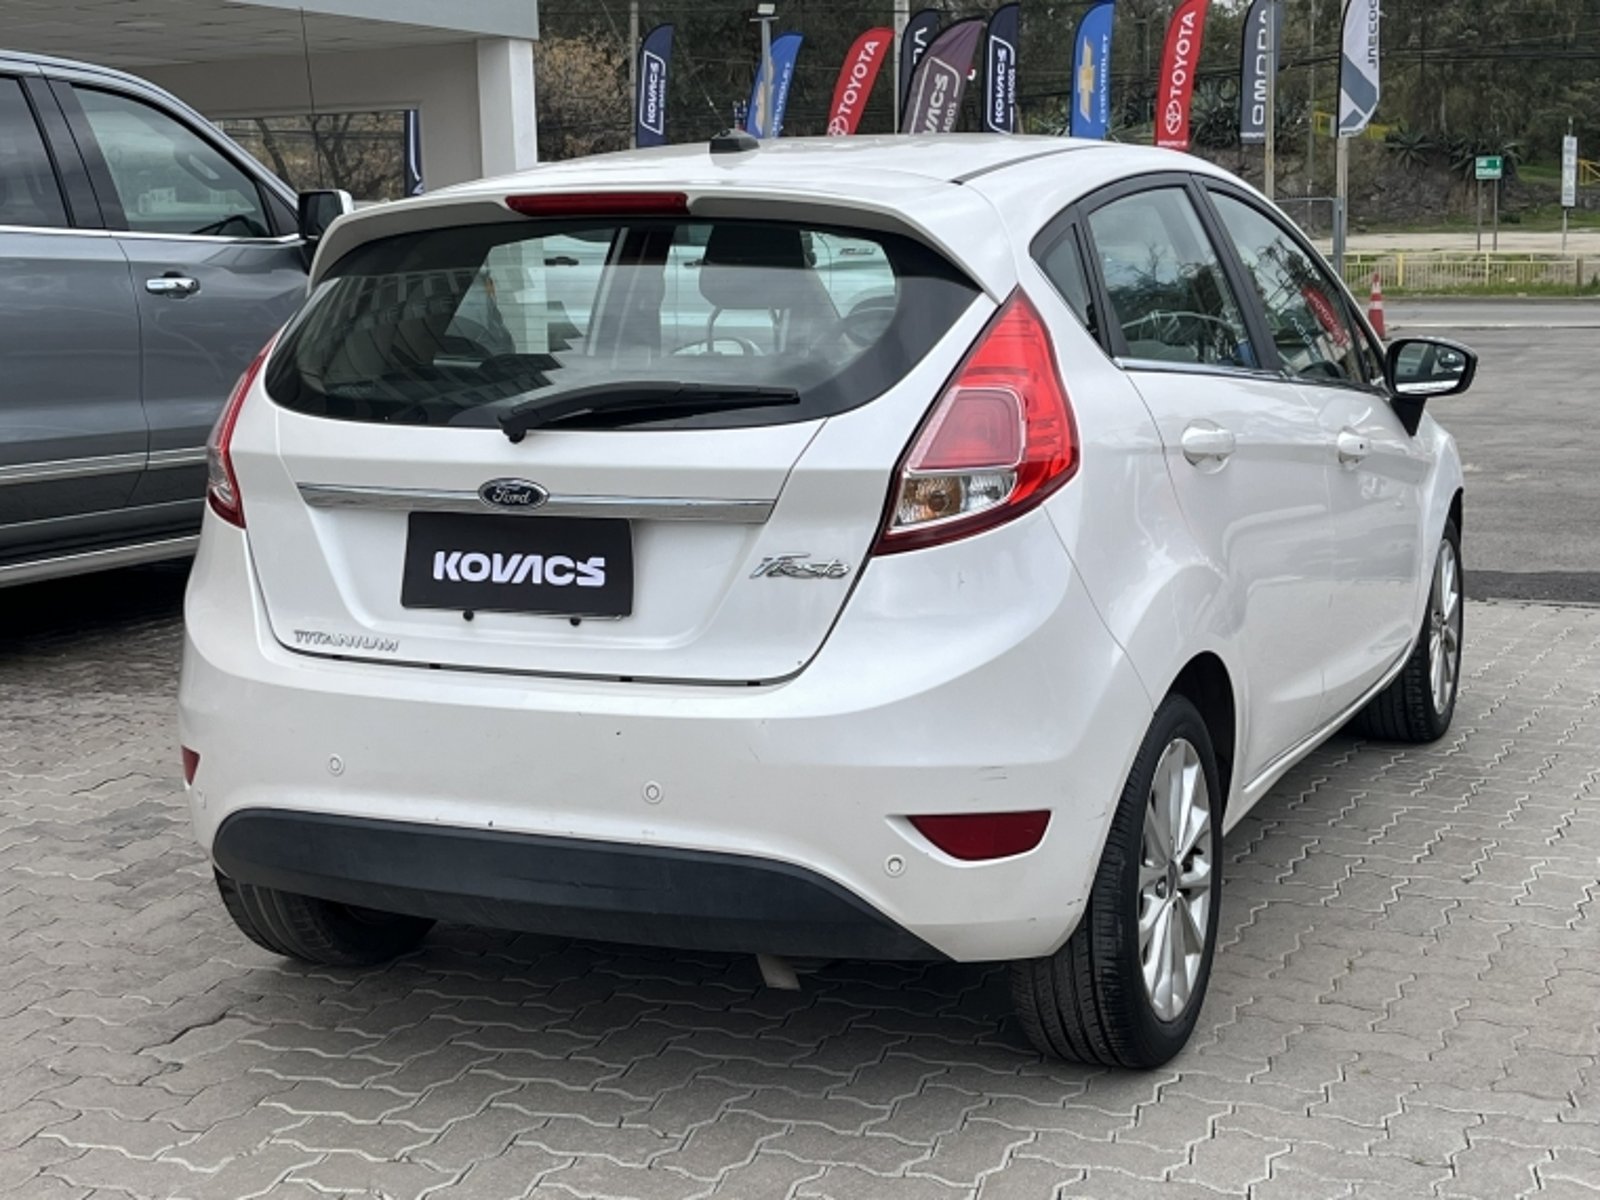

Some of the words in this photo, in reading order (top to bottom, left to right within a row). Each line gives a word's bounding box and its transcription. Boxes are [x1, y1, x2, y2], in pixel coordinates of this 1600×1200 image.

[838, 41, 880, 114] TOYOTA
[1170, 11, 1196, 98] TOYOTA
[647, 62, 660, 123] KOVACS
[922, 73, 948, 133] VACS
[995, 48, 1007, 124] KOVACS
[492, 486, 531, 504] Ford
[432, 550, 606, 587] KOVACS
[749, 552, 850, 579] Fiesta
[294, 629, 400, 652] TITANIUM
